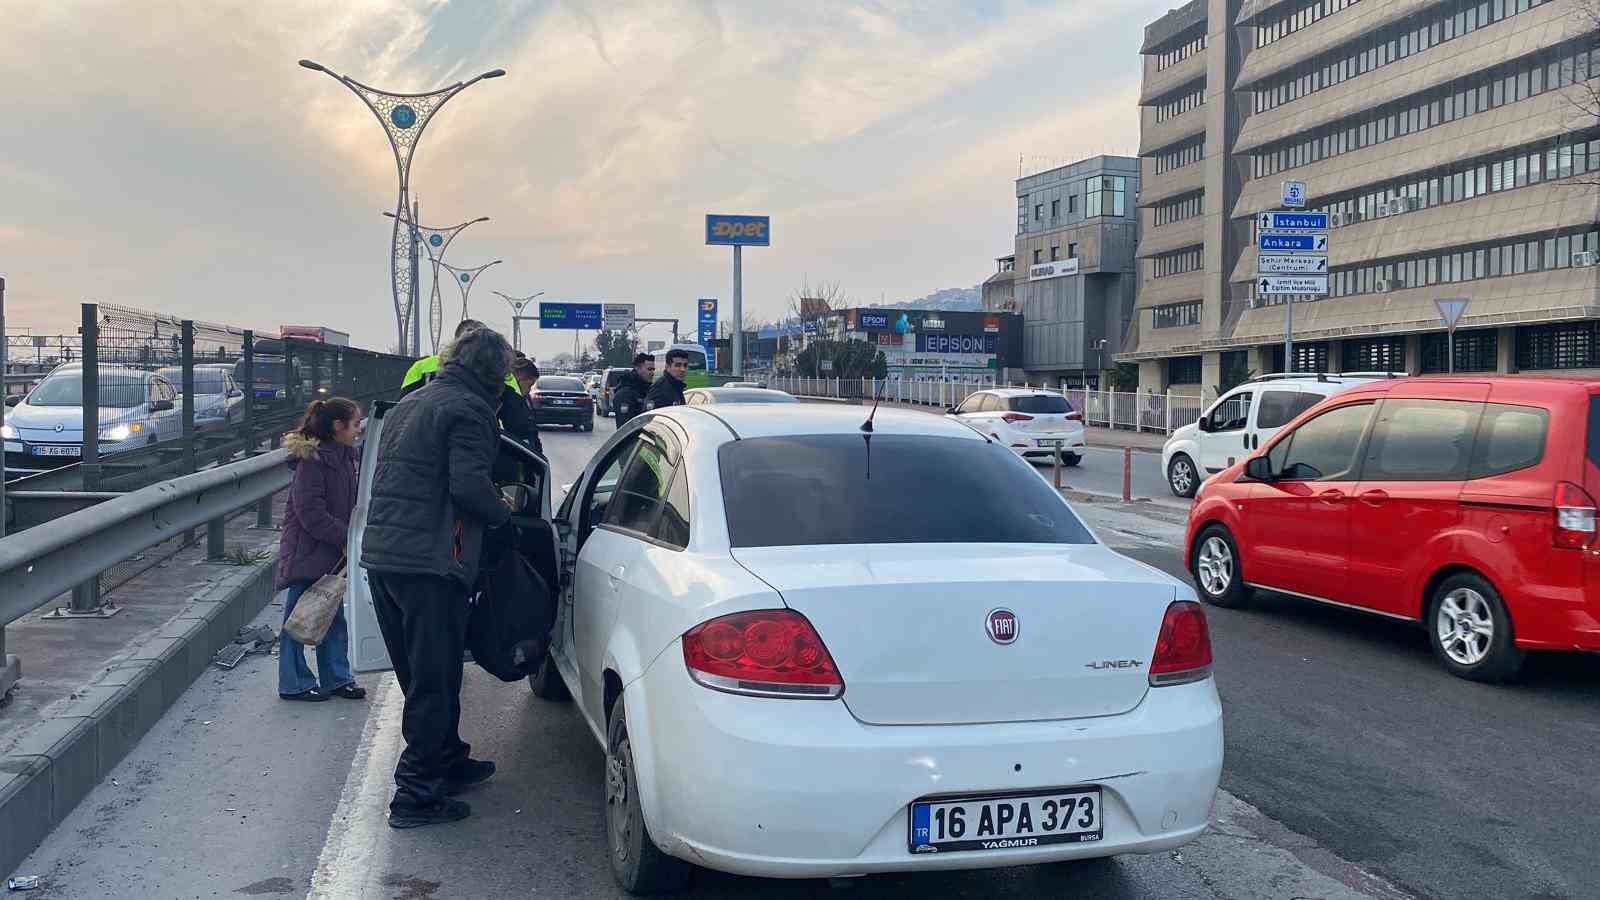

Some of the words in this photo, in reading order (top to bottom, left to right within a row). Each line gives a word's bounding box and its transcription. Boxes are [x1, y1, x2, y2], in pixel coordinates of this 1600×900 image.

[1263, 238, 1303, 248] Ankara
[862, 316, 887, 324] EPSON
[927, 337, 984, 351] EPSON
[994, 618, 1013, 635] FIAT
[1090, 659, 1141, 670] LINEA
[935, 806, 966, 839] 16
[976, 802, 1034, 836] APA
[1041, 796, 1094, 831] 373
[916, 827, 928, 838] TR
[1080, 833, 1100, 842] BURSA
[982, 838, 1038, 849] YAĞMUR
